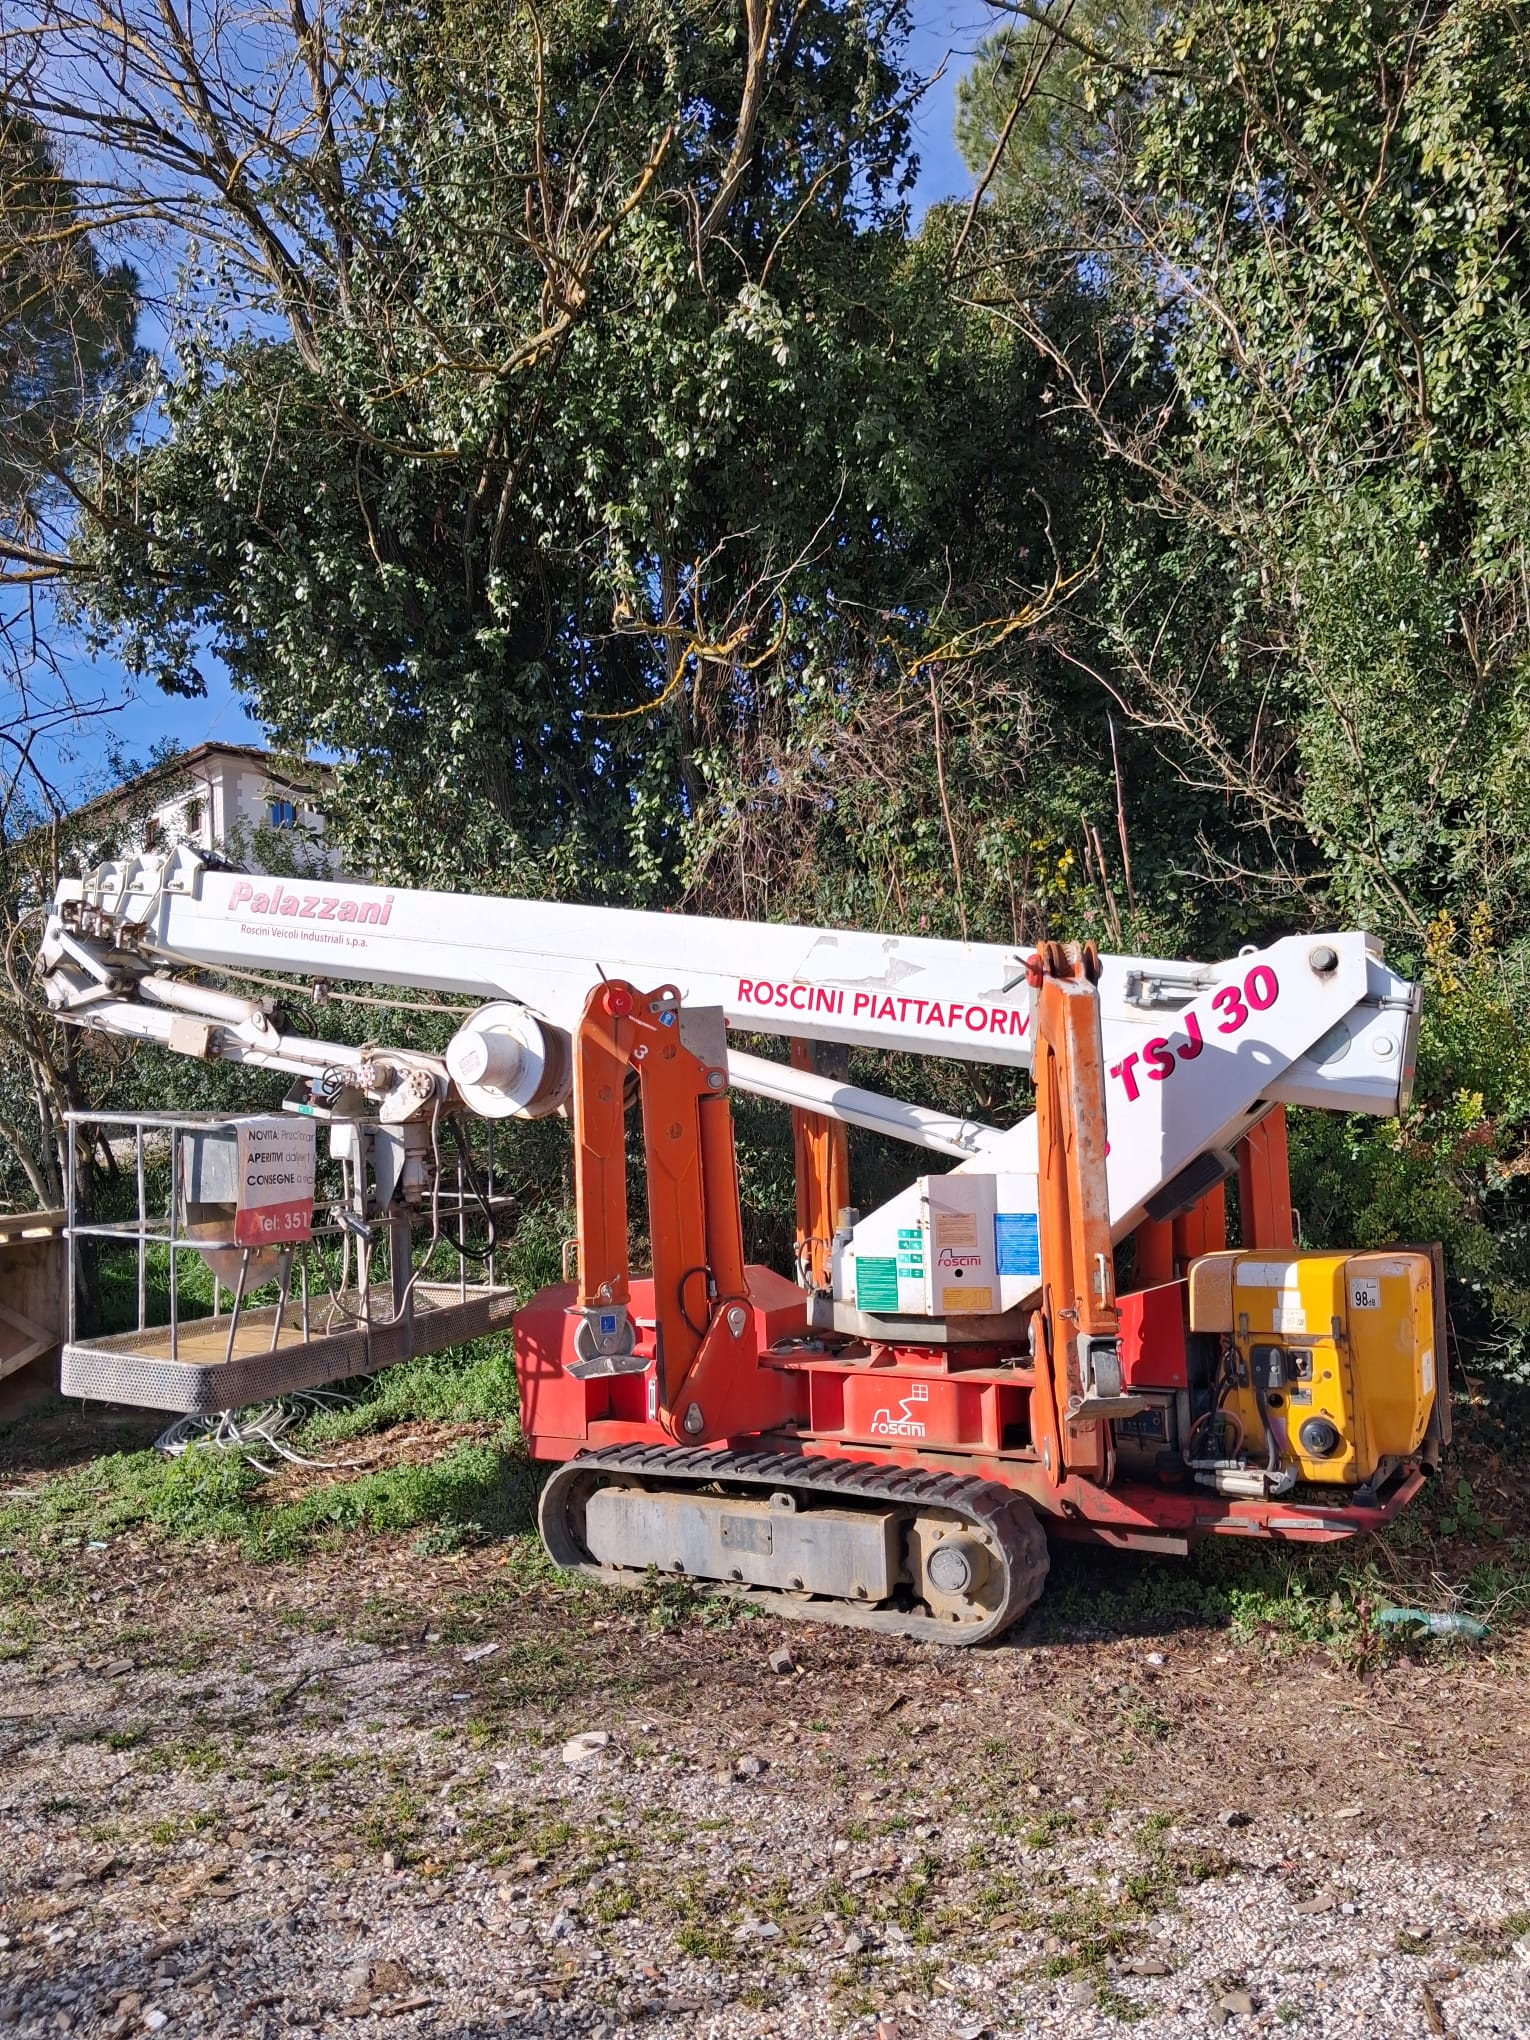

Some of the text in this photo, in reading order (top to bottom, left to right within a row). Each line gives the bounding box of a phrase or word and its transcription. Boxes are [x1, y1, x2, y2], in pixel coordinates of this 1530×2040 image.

[228, 881, 395, 925] Palazzani
[241, 923, 368, 948] Roscini Veicoli Industriali s.p.a.
[737, 979, 1030, 1037] ROSCINI PIATTAFORM
[1109, 965, 1279, 1102] TSJ 30
[633, 1044, 649, 1060] 3
[247, 1152, 284, 1163] APERITIVI
[247, 1174, 295, 1186] CONSEGNE
[258, 1212, 312, 1232] Tel: 351
[938, 1257, 981, 1266] roscini
[1355, 1291, 1368, 1306] 98
[871, 1423, 925, 1437] roscini
